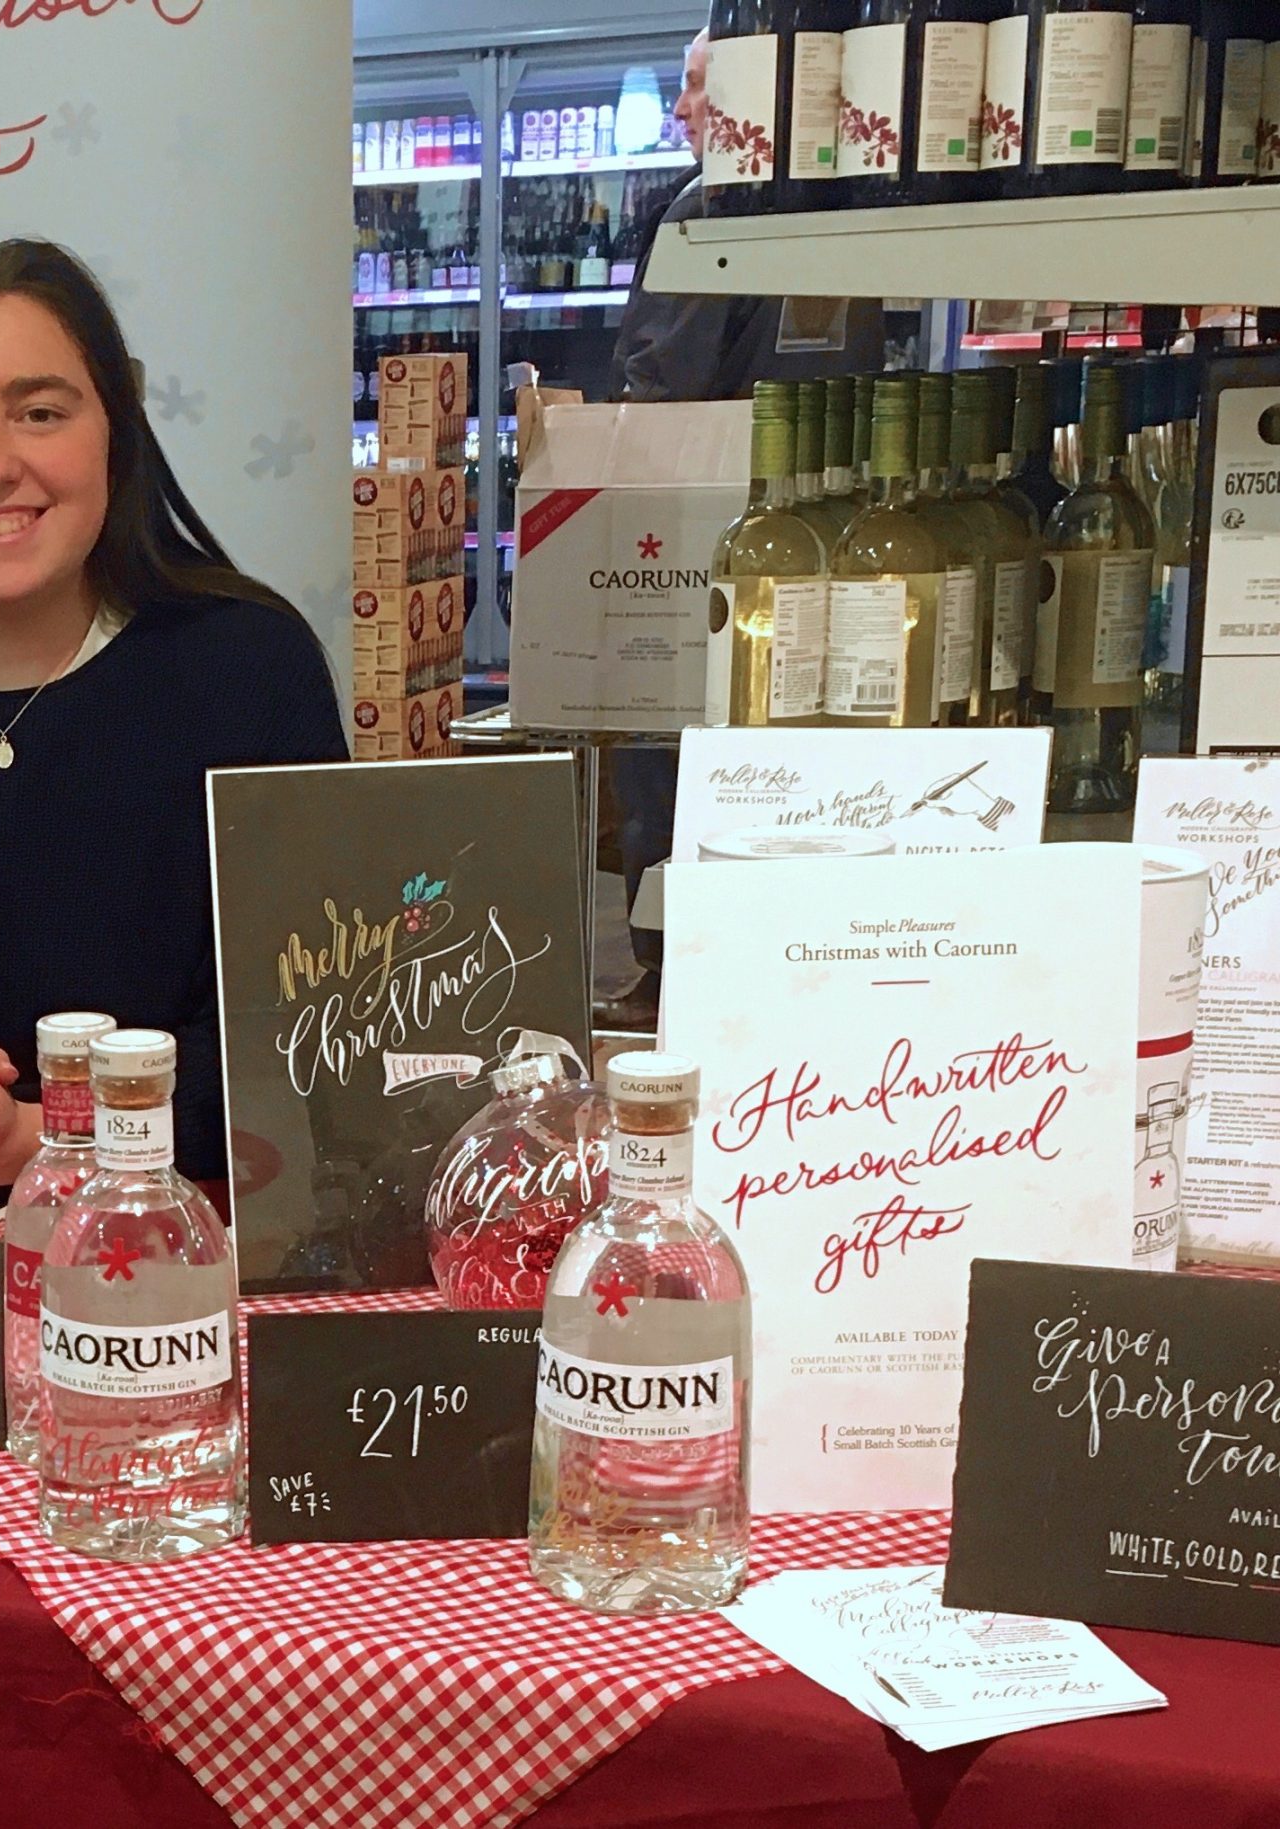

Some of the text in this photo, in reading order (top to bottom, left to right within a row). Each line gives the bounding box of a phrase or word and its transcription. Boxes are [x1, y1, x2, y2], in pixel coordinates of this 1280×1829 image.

[589, 570, 709, 591] CAORUNN
[715, 795, 787, 805] WORKSHOPS
[1177, 834, 1260, 844] WORKSHOPS
[849, 918, 956, 937] Simple Pleasures
[785, 939, 1018, 962] Christmas with Caorunn
[275, 906, 552, 1097] Christmas
[62, 1039, 90, 1048] CAO
[391, 1058, 466, 1081] EVERYONE
[620, 1081, 683, 1094] CAORUNN
[107, 1115, 151, 1140] 1824
[620, 1140, 667, 1168] 1824
[722, 1085, 1068, 1230] personalised
[1187, 1156, 1227, 1166] STARTER
[1228, 1158, 1244, 1167] KIT
[814, 1195, 973, 1294] gifts
[40, 1319, 219, 1374] CAORUNN
[834, 1330, 959, 1343] AVAILABLE TODAY
[790, 1353, 943, 1365] COMPLIMENTARY WITH THE
[1033, 1317, 1156, 1392] Give
[791, 1367, 804, 1375] OF
[867, 1364, 882, 1373] OR
[887, 1363, 939, 1372] SCOTTISH
[80, 1380, 116, 1393] BATCH
[118, 1382, 176, 1394] SCOTTISH
[178, 1379, 197, 1389] GIN
[539, 1348, 720, 1415] CAORUNN
[567, 1416, 600, 1432] BATCH
[603, 1425, 666, 1436] SCOTTISH
[668, 1425, 691, 1436] GIN
[837, 1424, 955, 1437] Celebrating 10 Years of
[834, 1439, 862, 1450] Small
[865, 1439, 894, 1449] Batch
[897, 1438, 937, 1448] Scottish
[270, 1472, 314, 1501] SAVE
[290, 1493, 316, 1517] £7
[931, 1653, 1080, 1670] WORKSHOPS
